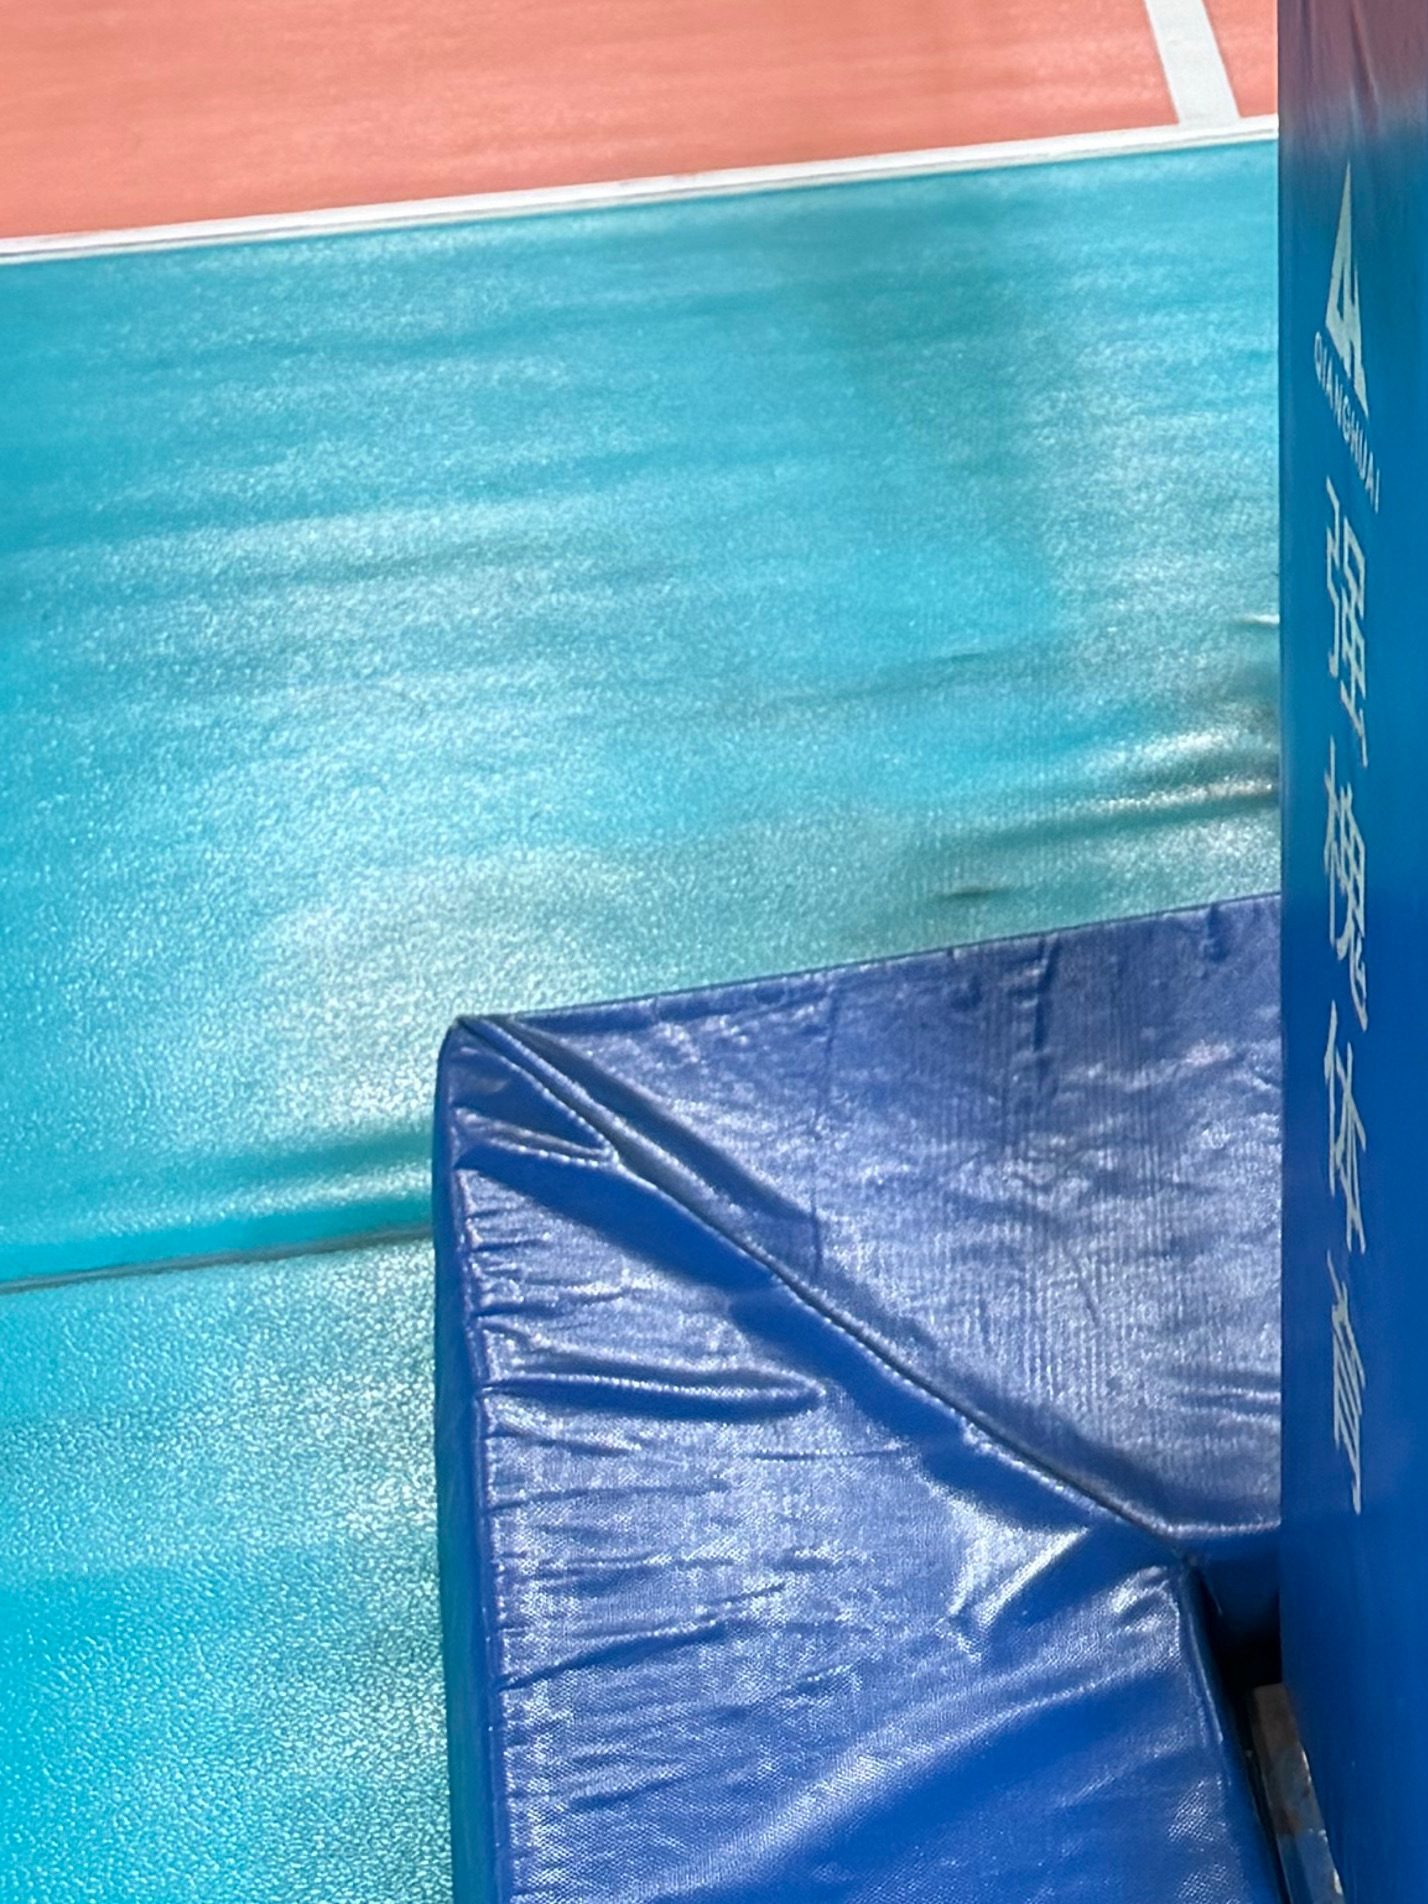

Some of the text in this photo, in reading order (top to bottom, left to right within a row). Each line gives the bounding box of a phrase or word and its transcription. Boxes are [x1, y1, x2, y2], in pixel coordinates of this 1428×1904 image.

[1314, 330, 1381, 515] QIANGHUAI
[1323, 473, 1370, 1516] 强槐体育
